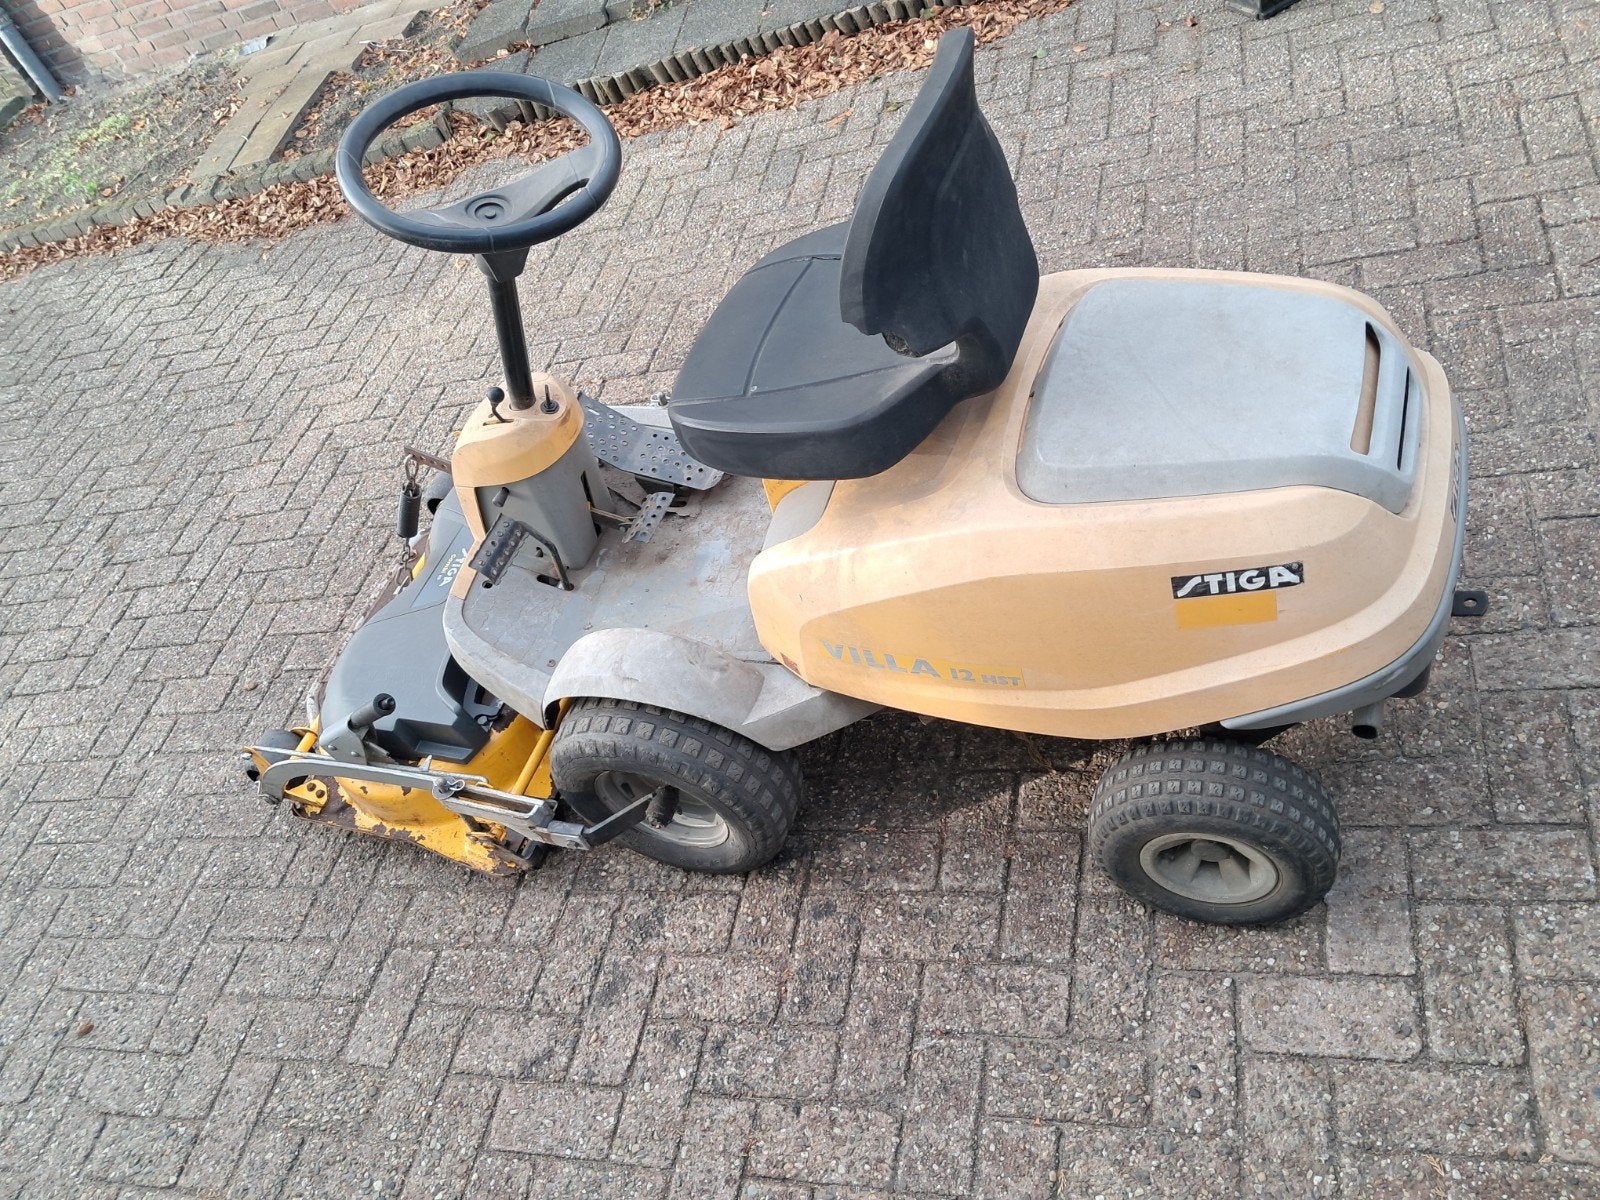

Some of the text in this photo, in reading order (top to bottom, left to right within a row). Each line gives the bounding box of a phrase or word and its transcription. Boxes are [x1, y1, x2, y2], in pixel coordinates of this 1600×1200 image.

[1177, 566, 1300, 597] STIGA
[821, 639, 1022, 686] VILLA 12 HST
